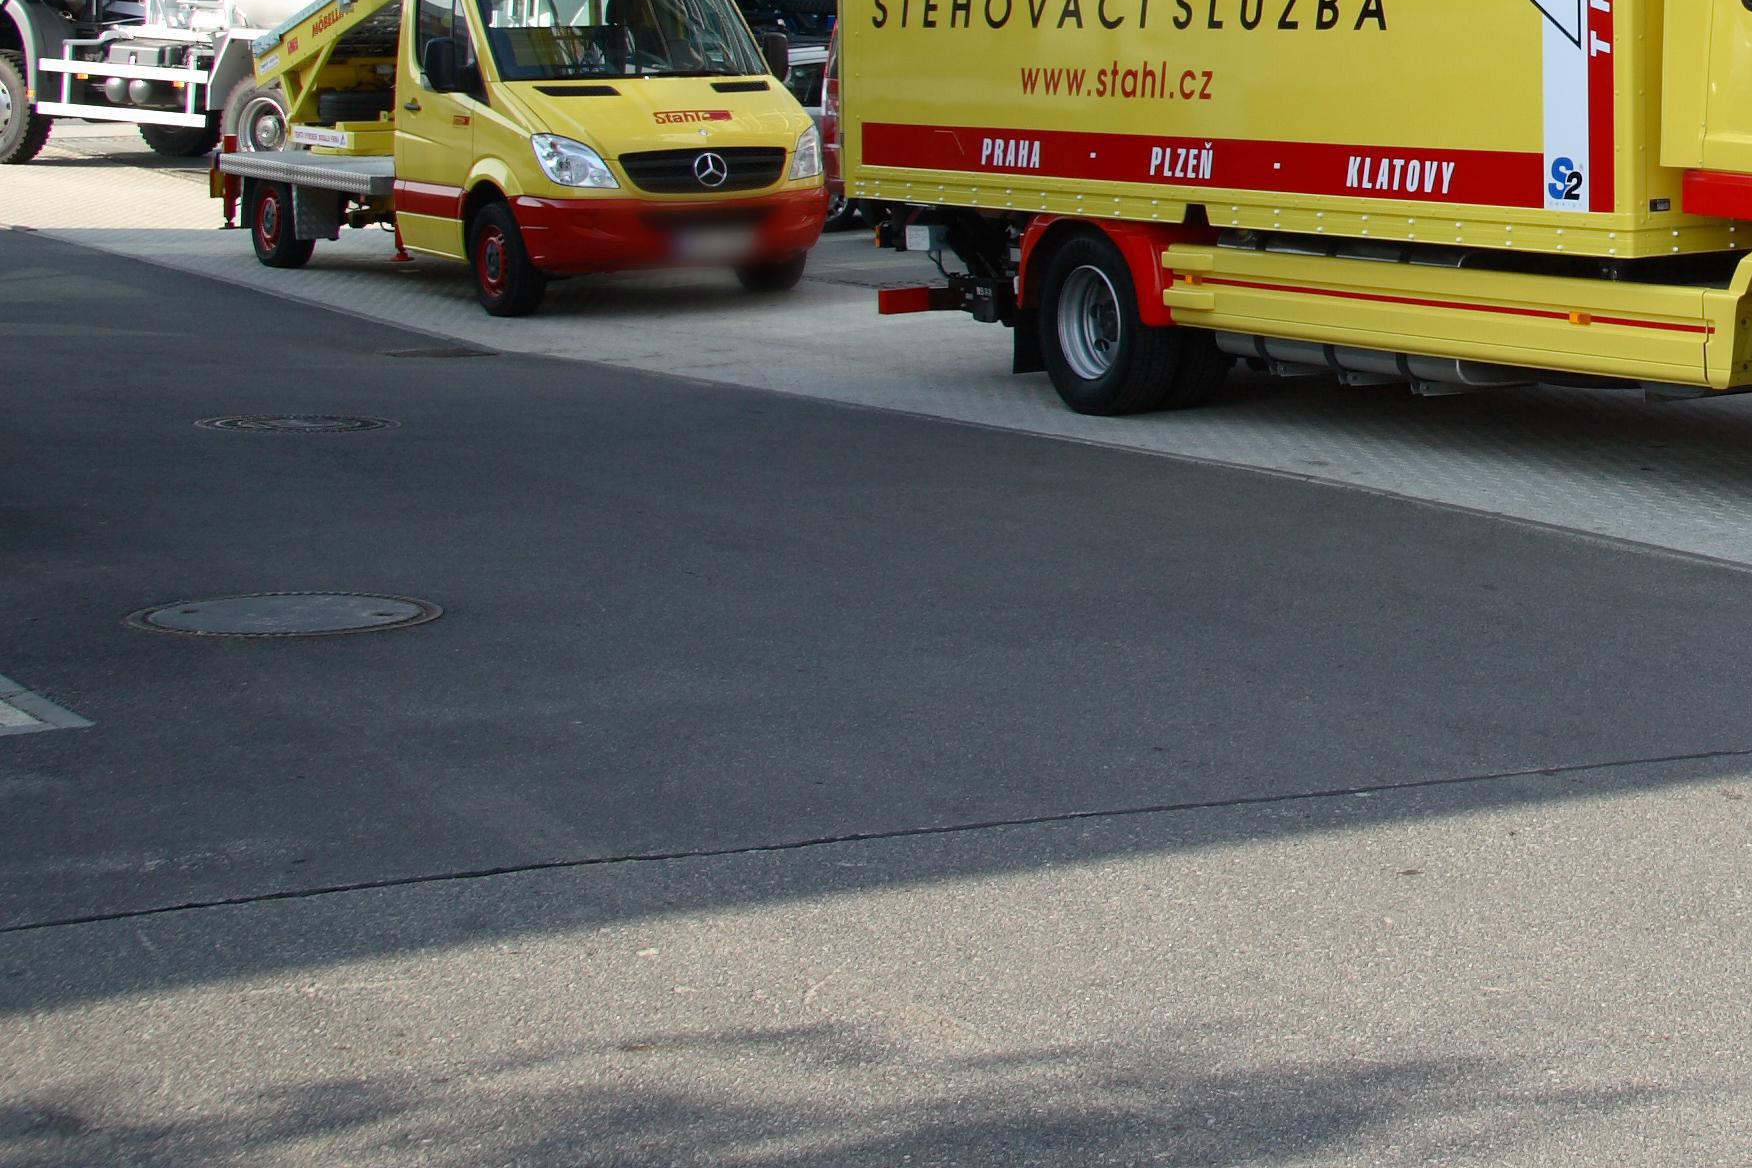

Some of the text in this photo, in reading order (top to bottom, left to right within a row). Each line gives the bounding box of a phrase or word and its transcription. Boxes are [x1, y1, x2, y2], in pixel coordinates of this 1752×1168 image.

[1020, 60, 1214, 100] www.stahl.cz
[980, 138, 1455, 194] PRAHA PLZEŇ KLATOVY
[1548, 157, 1583, 201] S2
